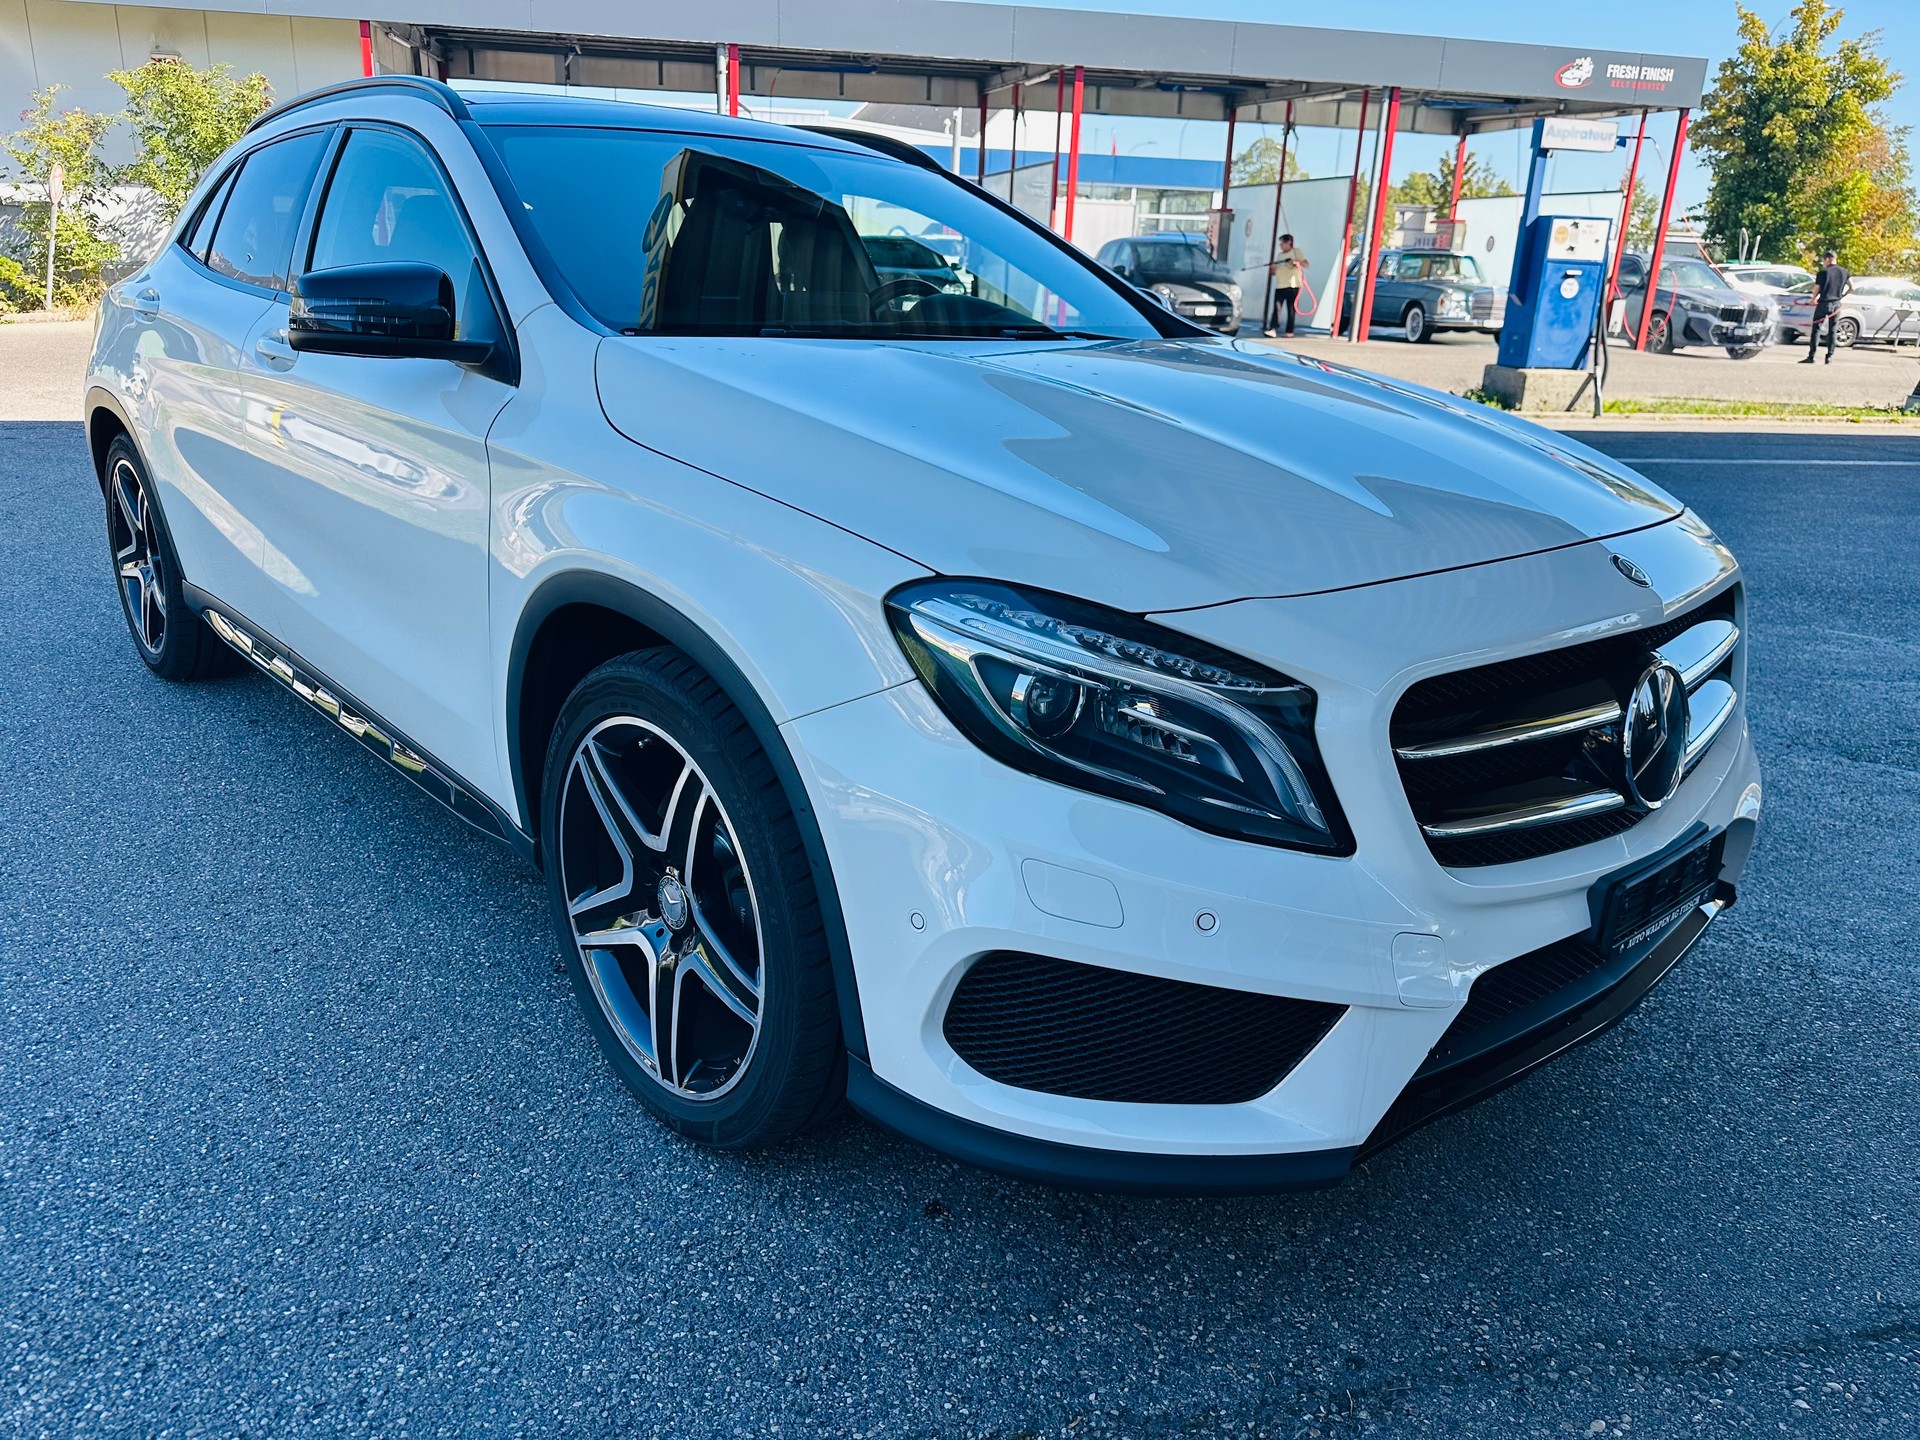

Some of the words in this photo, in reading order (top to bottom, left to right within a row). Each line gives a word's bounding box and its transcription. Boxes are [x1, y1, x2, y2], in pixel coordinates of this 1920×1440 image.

[1606, 64, 1640, 79] FRESH
[1640, 66, 1675, 82] FINISH
[1546, 125, 1616, 142] Aspirateur
[1627, 931, 1645, 949] AUTO
[1645, 915, 1671, 937] WALPEN
[1670, 908, 1680, 922] AG
